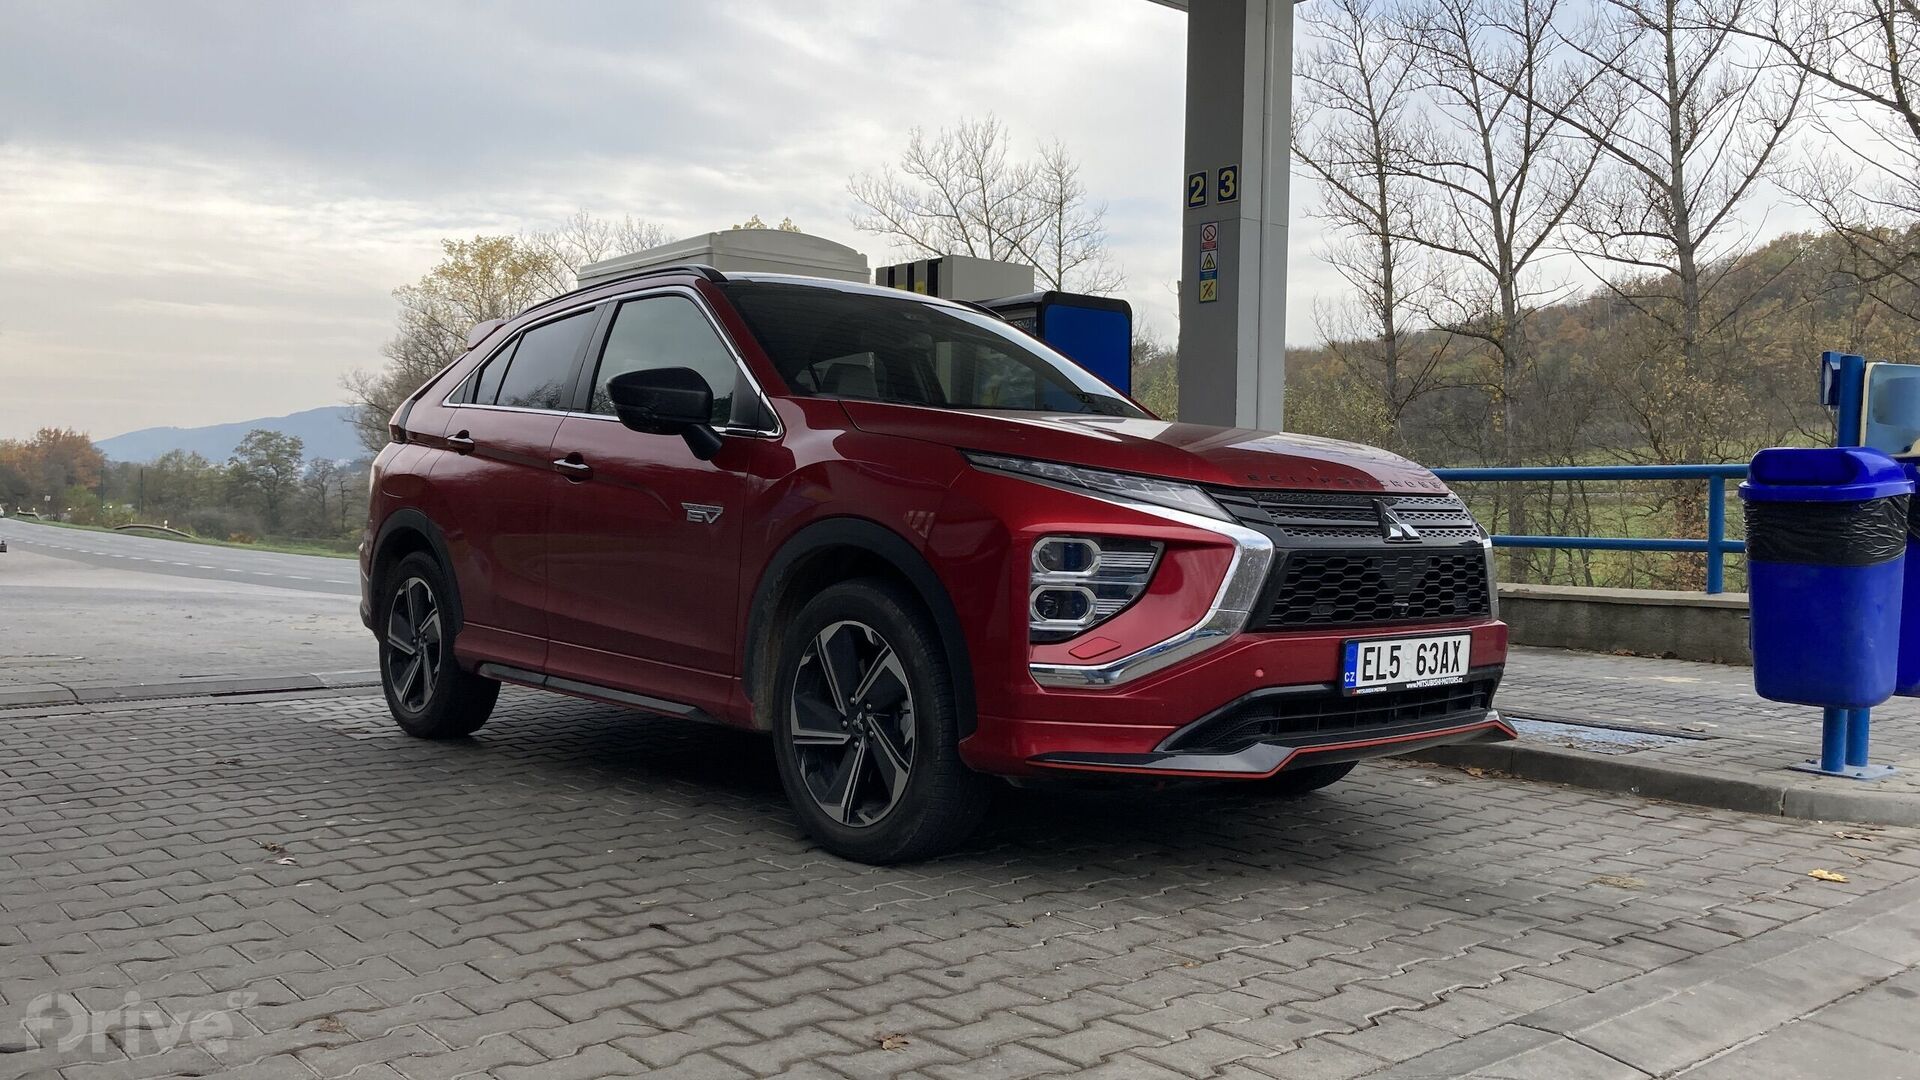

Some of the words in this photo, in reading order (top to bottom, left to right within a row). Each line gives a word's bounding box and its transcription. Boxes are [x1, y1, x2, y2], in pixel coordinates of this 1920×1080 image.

[1190, 175, 1205, 204] 2
[1219, 169, 1236, 199] 3
[1362, 645, 1402, 681] EL5
[1416, 640, 1461, 676] 63AX
[1344, 671, 1355, 682] CZ
